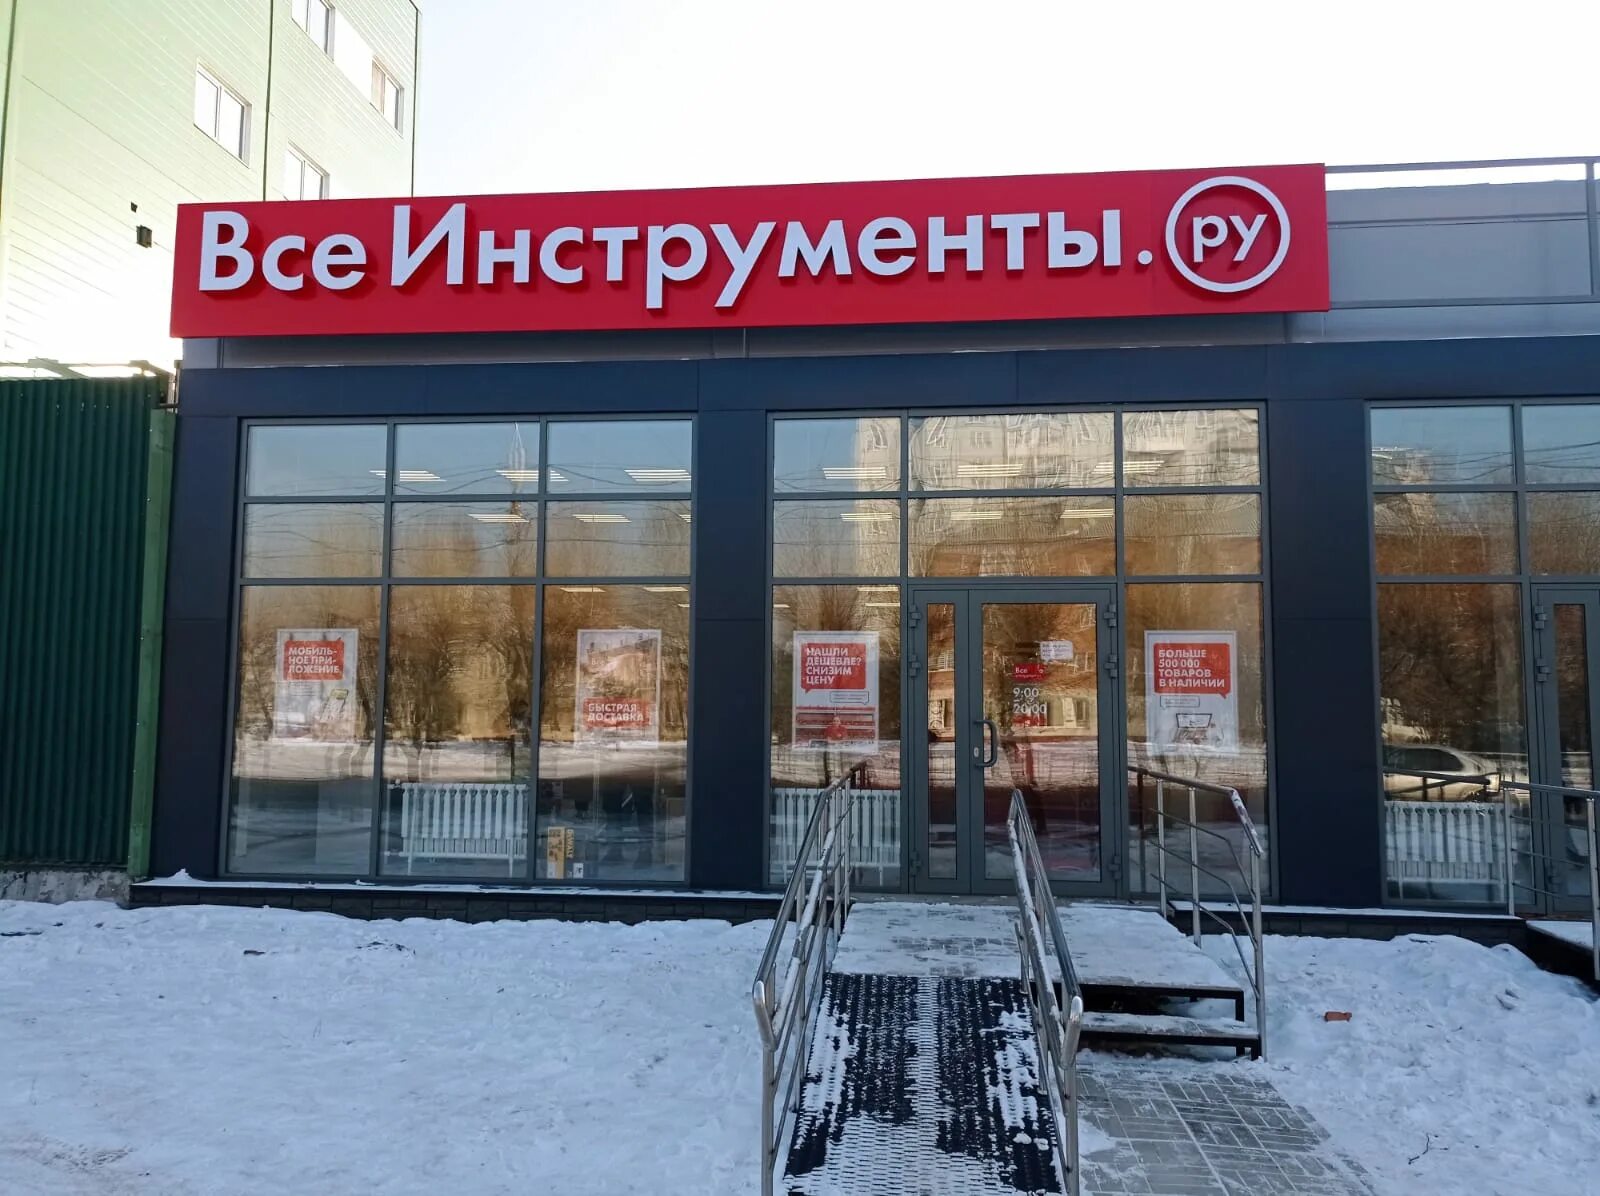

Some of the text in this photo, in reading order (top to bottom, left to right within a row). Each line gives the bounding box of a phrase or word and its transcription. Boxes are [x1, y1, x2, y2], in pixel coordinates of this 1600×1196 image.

[199, 210, 367, 292] Все
[288, 647, 338, 656] МОБИЛЬ-
[806, 648, 848, 657] НАШЛИ
[1158, 649, 1207, 658] БОЛЬШЕ
[288, 656, 337, 665] НОЕ ПРИ-
[805, 657, 862, 666] ДЕШЕВЛЕ?
[1158, 659, 1178, 668] 500
[288, 665, 340, 674] ЛОЖЕНИЕ
[806, 666, 852, 676] СНИЗИМ
[1158, 669, 1212, 678] ТОВАРОВ
[806, 676, 835, 685] ЦЕНУ
[1159, 678, 1225, 688] В НАЛИЧИИ
[1013, 687, 1039, 698] 9:00
[588, 703, 637, 712] БЫСТРАЯ
[1013, 703, 1047, 714] 2000
[587, 712, 644, 722] ДОСТАВКА
